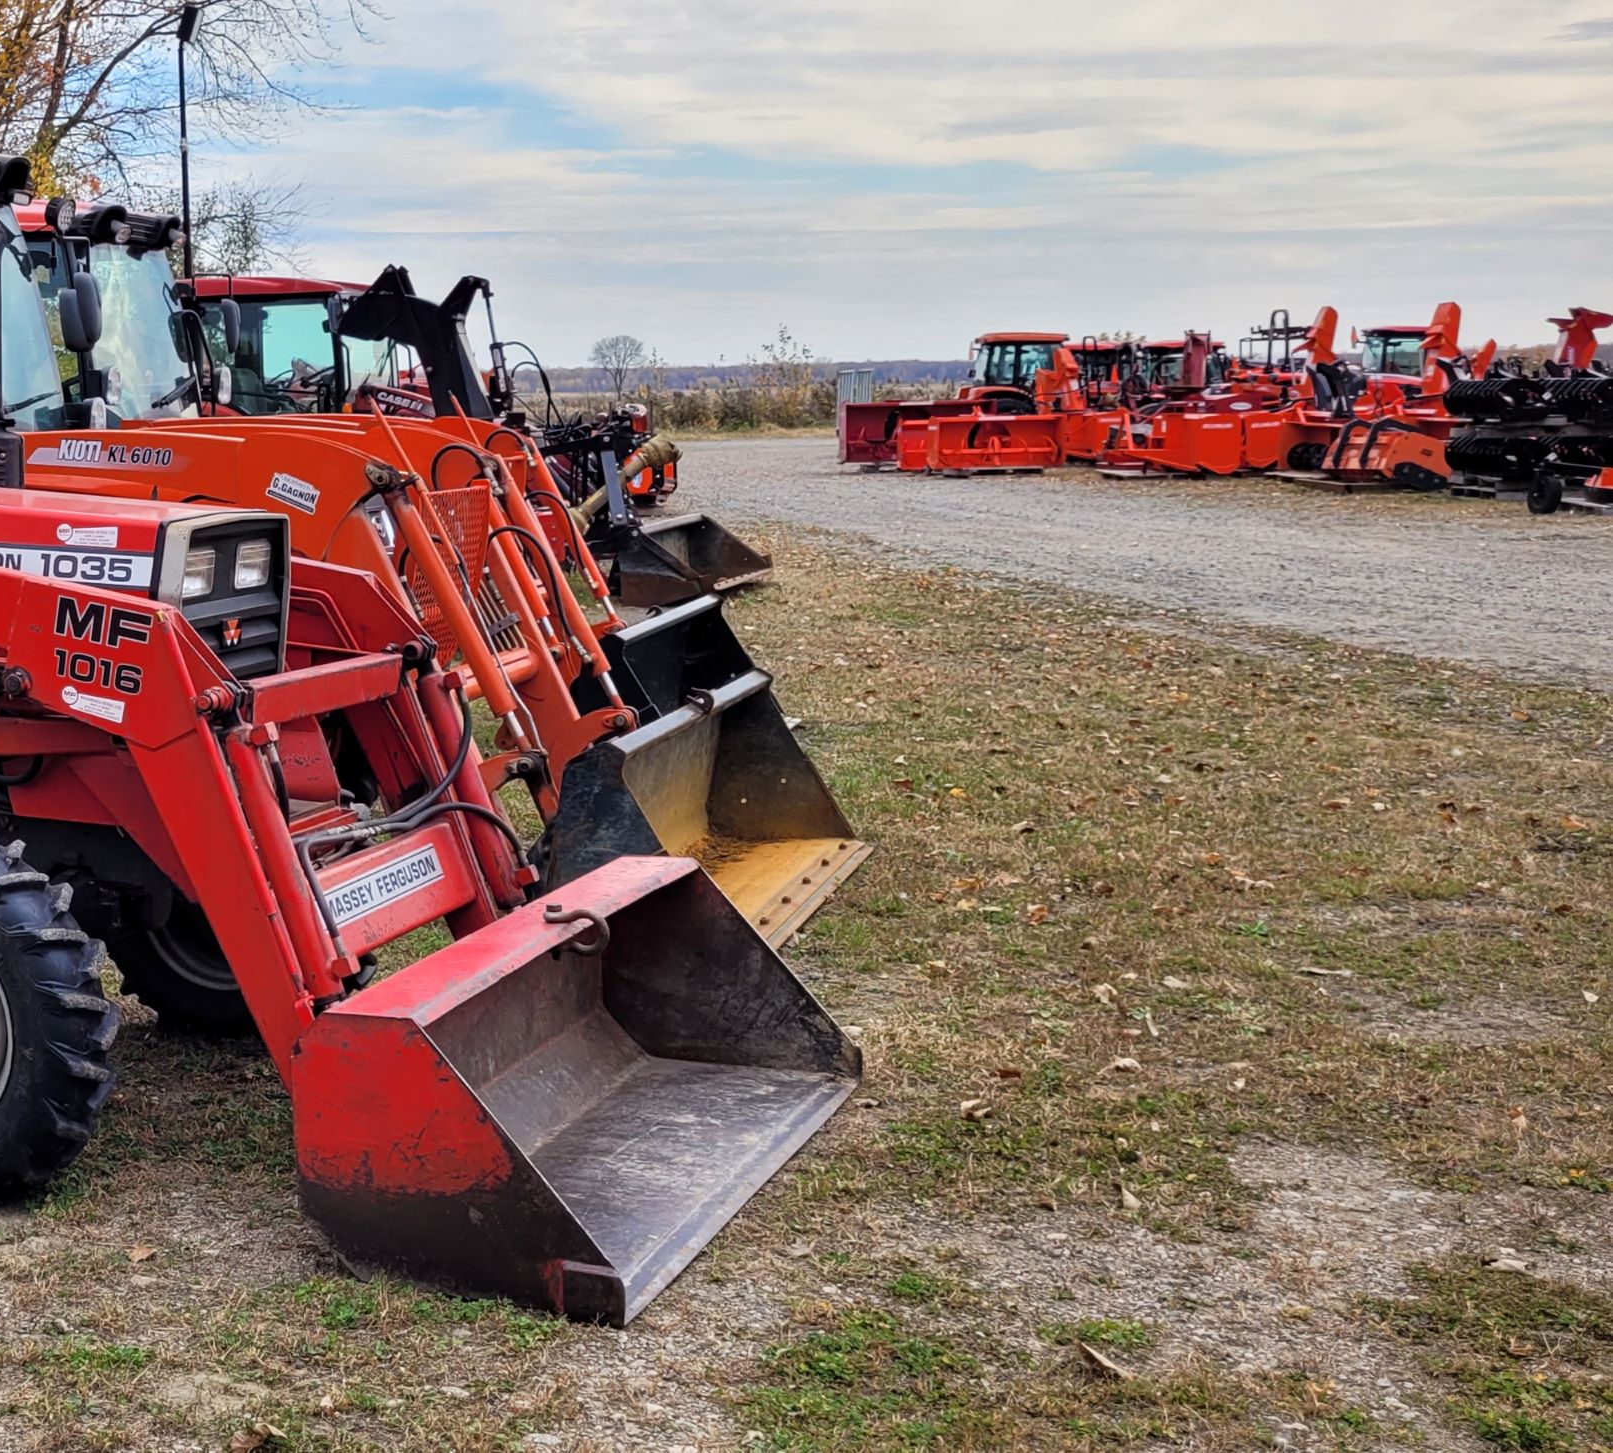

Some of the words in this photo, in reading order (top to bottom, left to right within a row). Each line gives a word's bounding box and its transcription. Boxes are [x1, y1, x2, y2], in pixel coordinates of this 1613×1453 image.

[377, 391, 410, 407] CASE
[58, 439, 102, 462] KIOTI
[107, 446, 127, 463] KL
[131, 448, 172, 466] 6010
[40, 552, 133, 583] 1035
[54, 595, 153, 649] MF
[54, 648, 143, 695] 1016
[376, 854, 437, 897] FERGUSON
